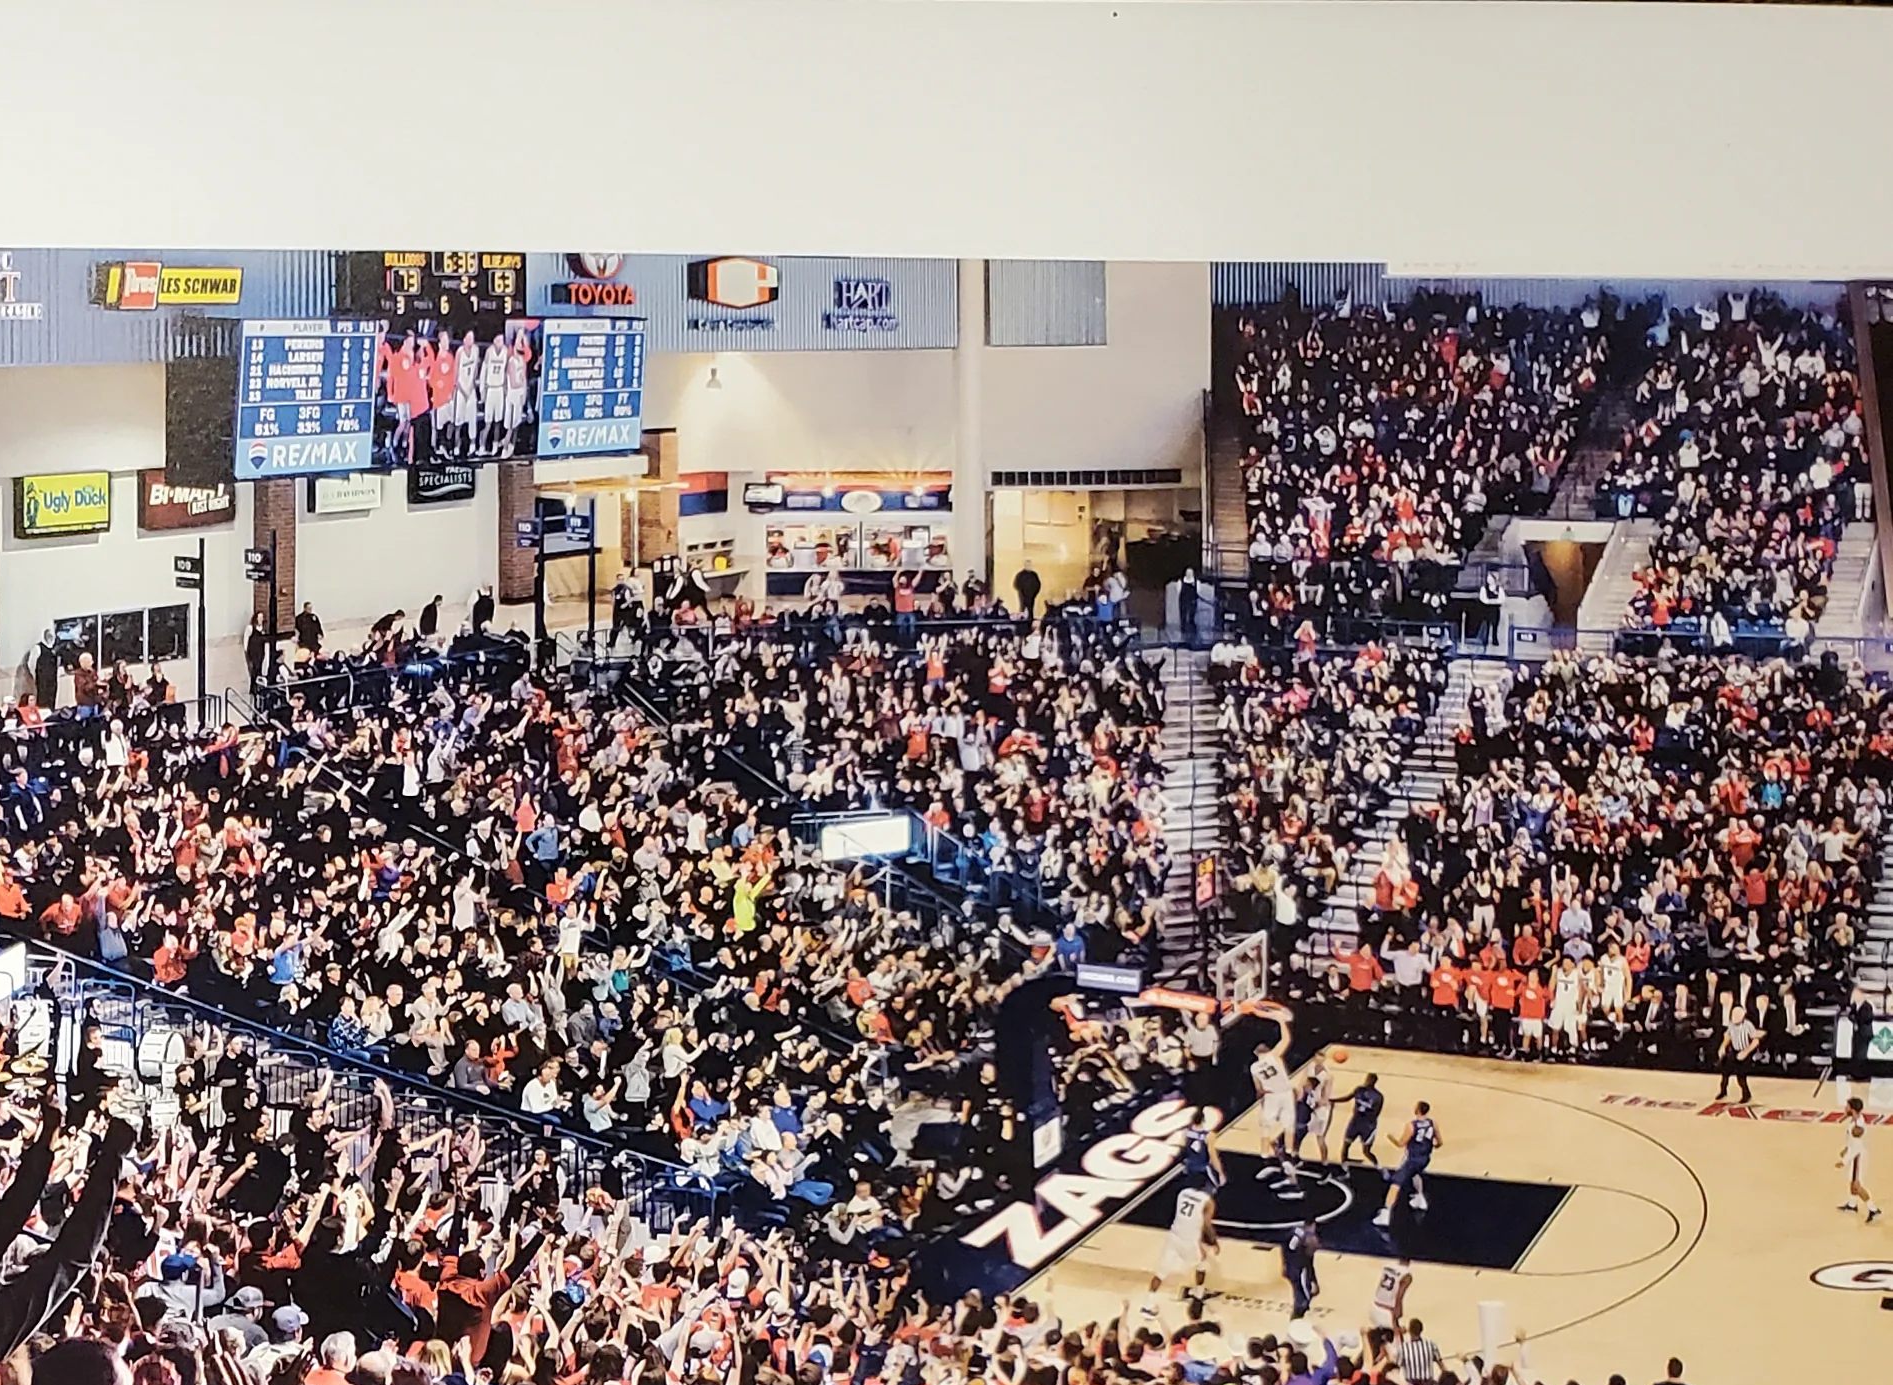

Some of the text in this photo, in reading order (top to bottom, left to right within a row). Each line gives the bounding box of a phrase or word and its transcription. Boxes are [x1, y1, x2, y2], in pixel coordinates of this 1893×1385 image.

[160, 277, 181, 294] LES
[568, 283, 636, 306] TOYOTA
[840, 280, 889, 309] HART
[260, 404, 355, 421] FG 3FG FT
[566, 424, 630, 447] RE/MAX
[272, 441, 358, 468] RE/MAX
[418, 472, 474, 487] SPECIALISTS
[43, 488, 106, 513] Ugly Duck
[247, 552, 261, 563] 110
[960, 1099, 1223, 1269] ZAGS
[1180, 1201, 1195, 1218] 21
